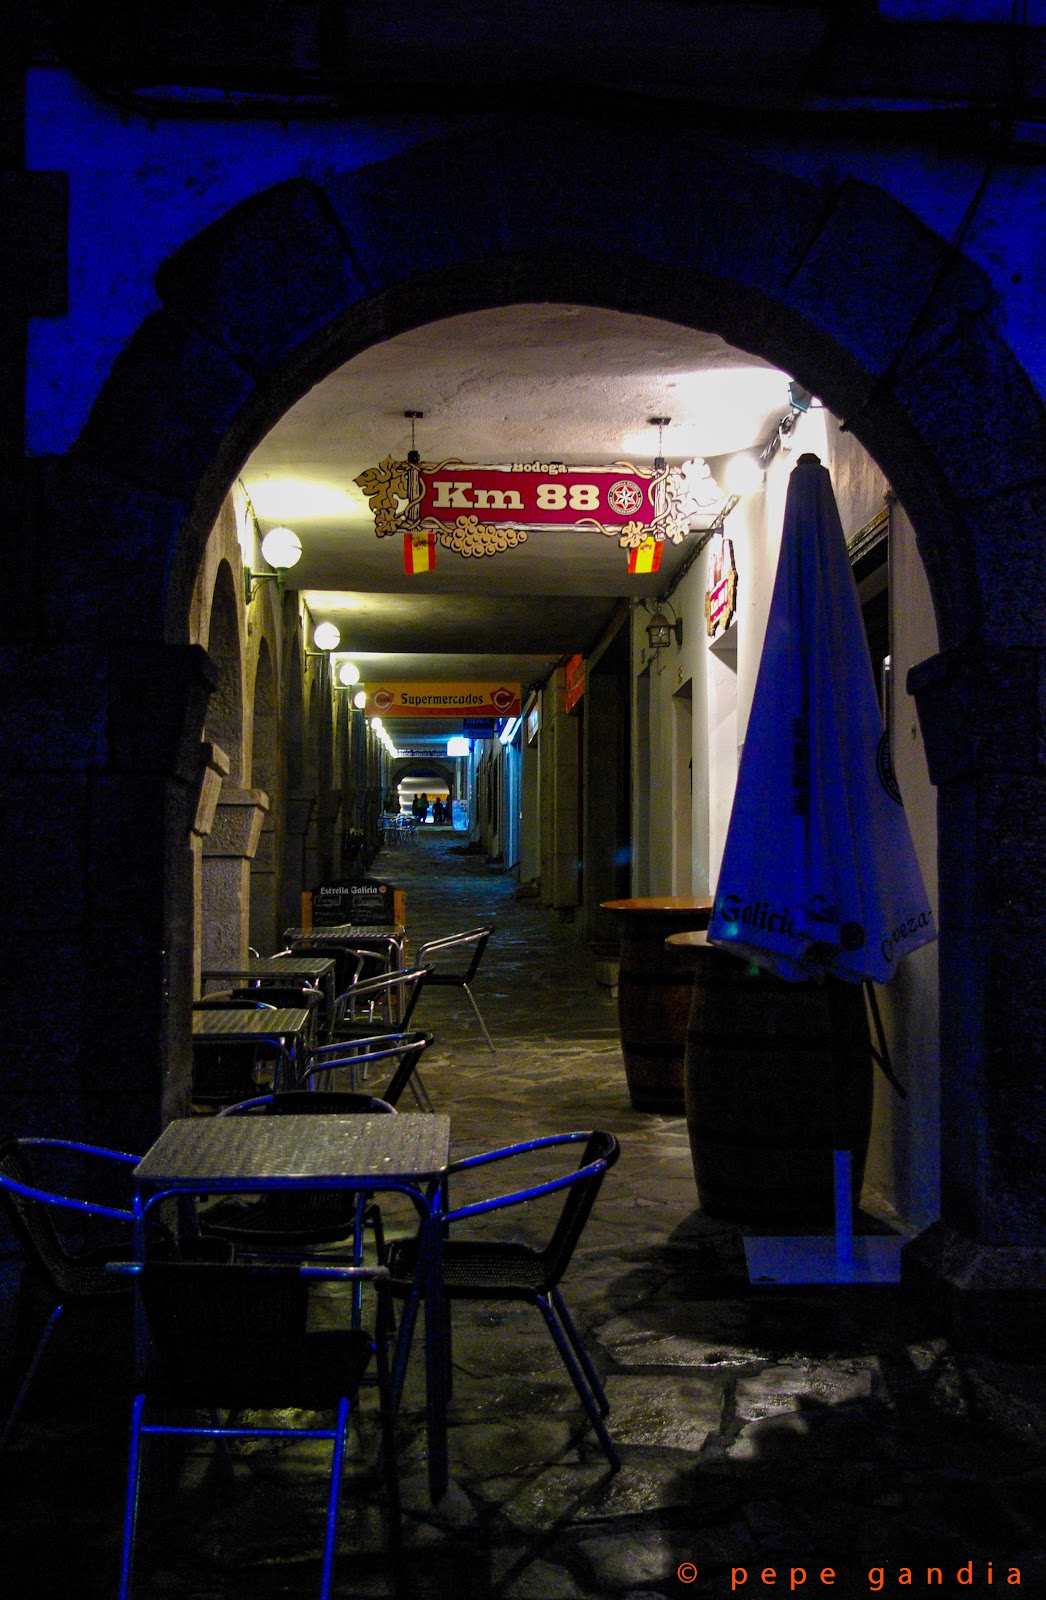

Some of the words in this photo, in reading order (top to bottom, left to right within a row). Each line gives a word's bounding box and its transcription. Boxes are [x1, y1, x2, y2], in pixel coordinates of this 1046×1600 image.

[511, 461, 568, 476] Bodega
[432, 481, 525, 510] Km
[535, 483, 601, 511] 88
[400, 693, 484, 707] Supermercados
[320, 885, 349, 895] Estrella
[350, 885, 378, 895] Galicia
[881, 913, 929, 963] Cveza
